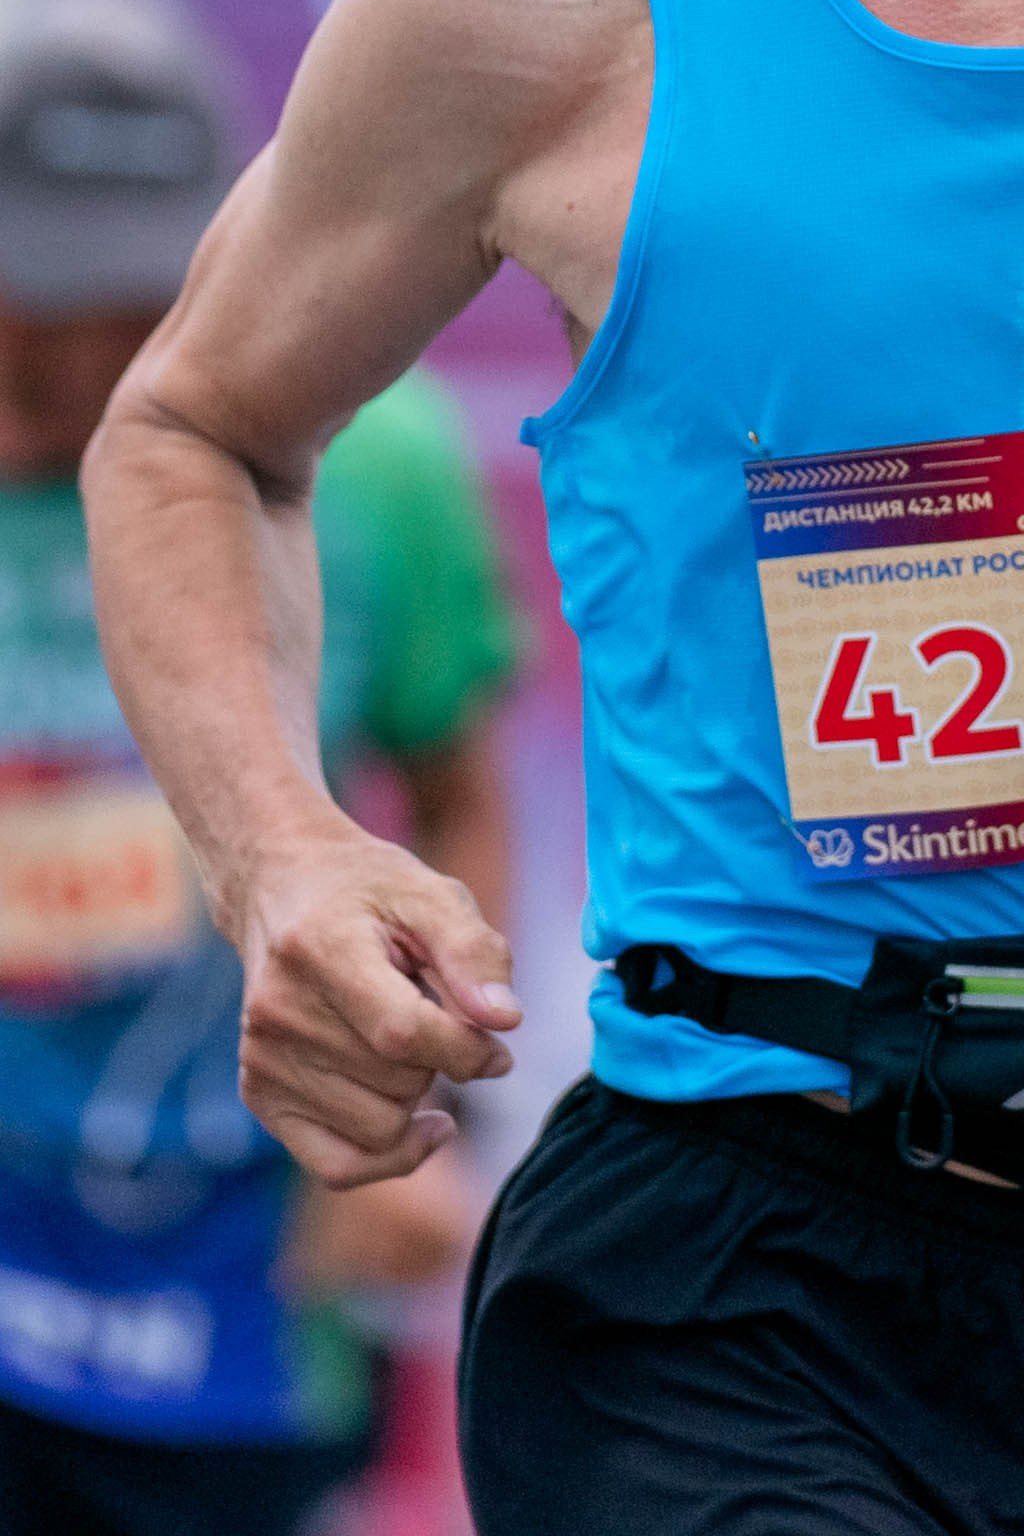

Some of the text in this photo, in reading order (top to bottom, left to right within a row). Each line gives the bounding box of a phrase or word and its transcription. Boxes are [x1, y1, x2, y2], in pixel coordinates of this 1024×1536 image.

[763, 491, 994, 533] ДИСТАНЦИЯ 42,2 КМ
[797, 558, 965, 590] ЧЕМПИОНАТ
